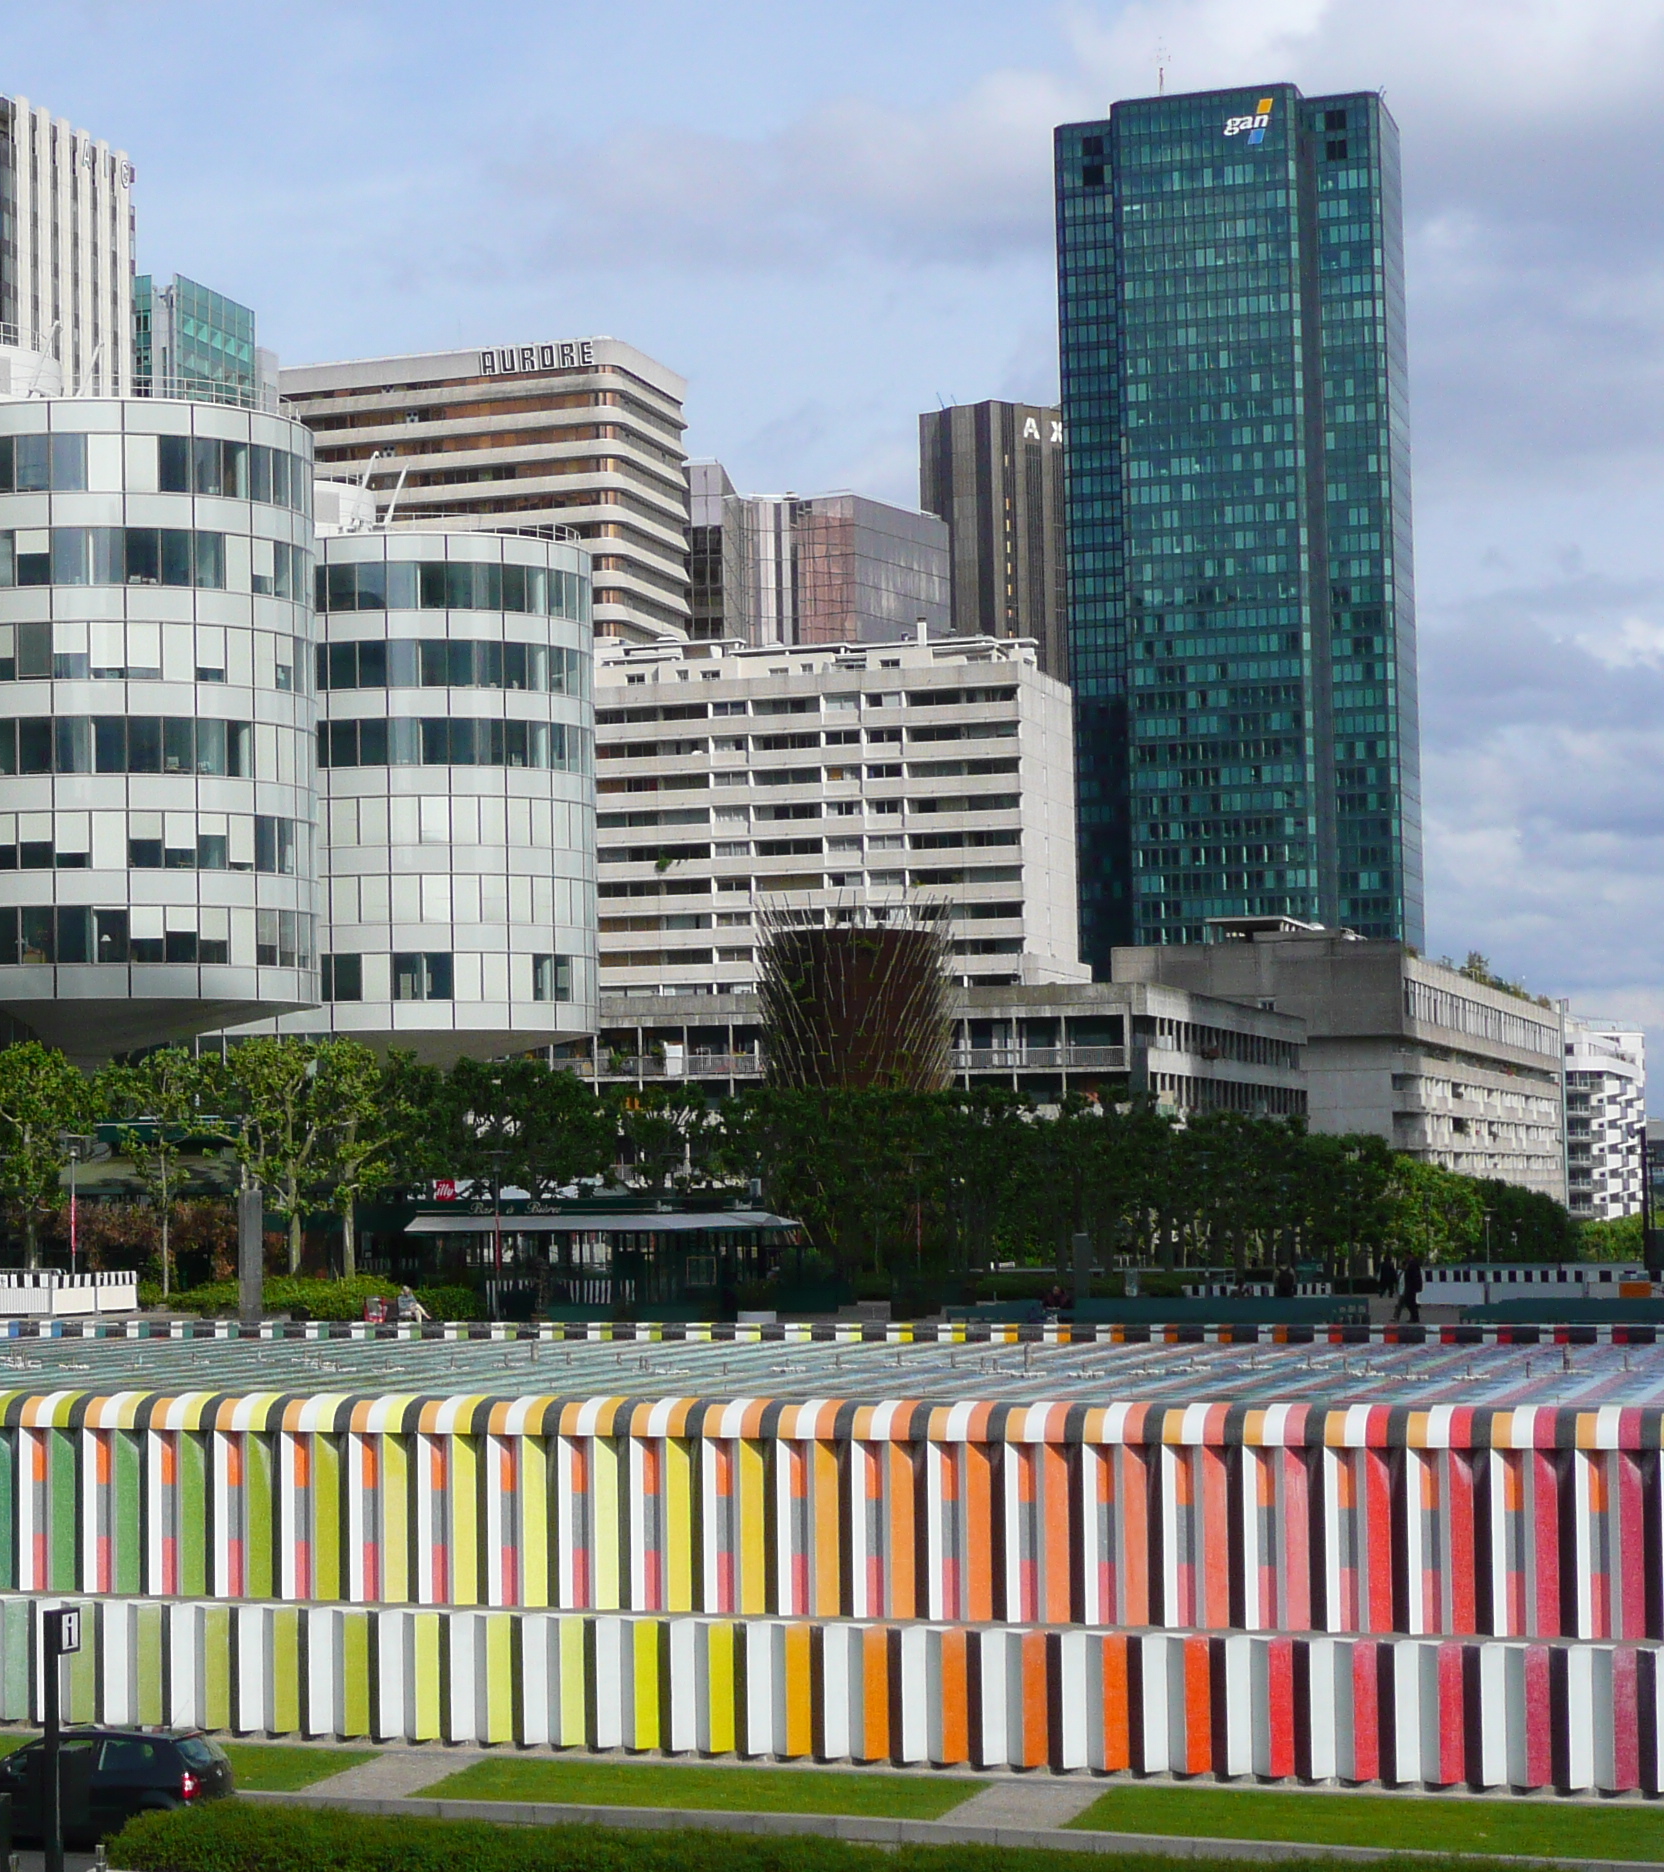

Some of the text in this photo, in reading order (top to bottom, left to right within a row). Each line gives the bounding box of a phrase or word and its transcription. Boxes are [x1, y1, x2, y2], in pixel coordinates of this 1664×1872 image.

[1223, 114, 1269, 136] gan
[480, 340, 594, 376] AURORE
[437, 1184, 455, 1199] illy
